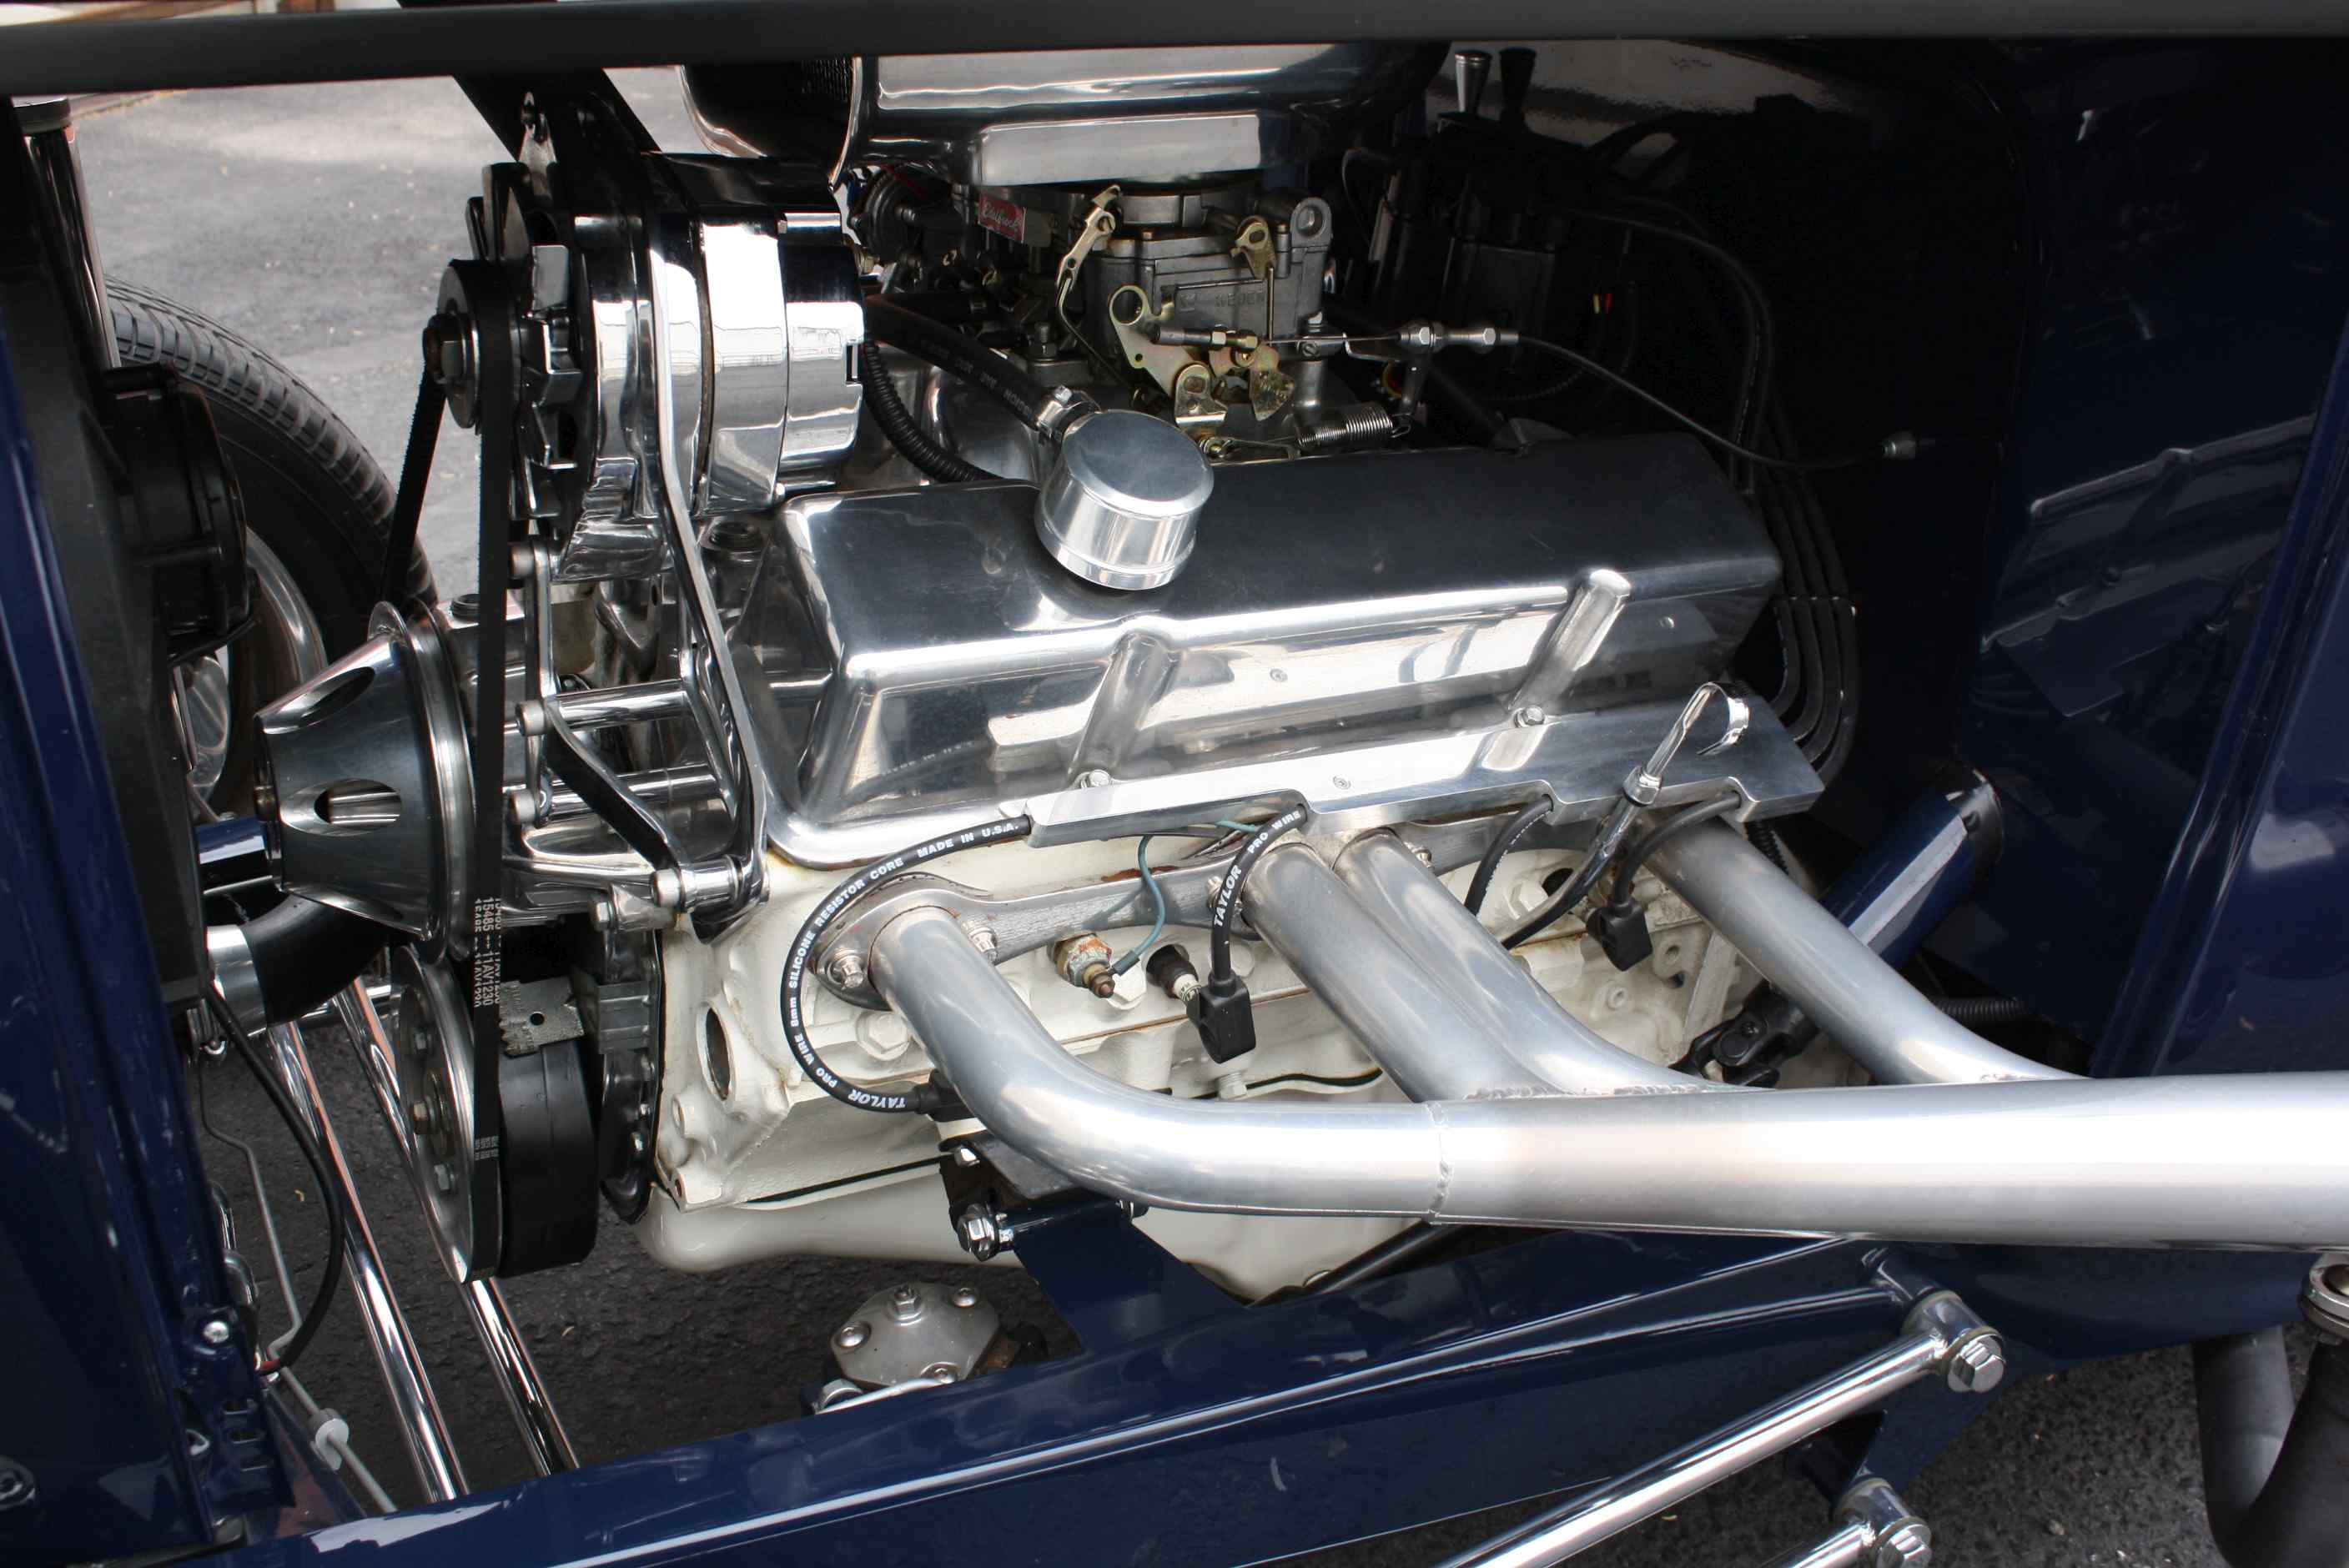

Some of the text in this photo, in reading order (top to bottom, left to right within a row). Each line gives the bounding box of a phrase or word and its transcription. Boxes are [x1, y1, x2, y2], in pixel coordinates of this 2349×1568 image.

[1214, 809, 1302, 927] TAYLOR PRO WIRE
[483, 897, 495, 1006] 15485 11AV1230
[789, 822, 1019, 1110] TAYLOR PRO WIRE 8mm SILICONE RESISTOR CORE MADE IN U.S.A.
